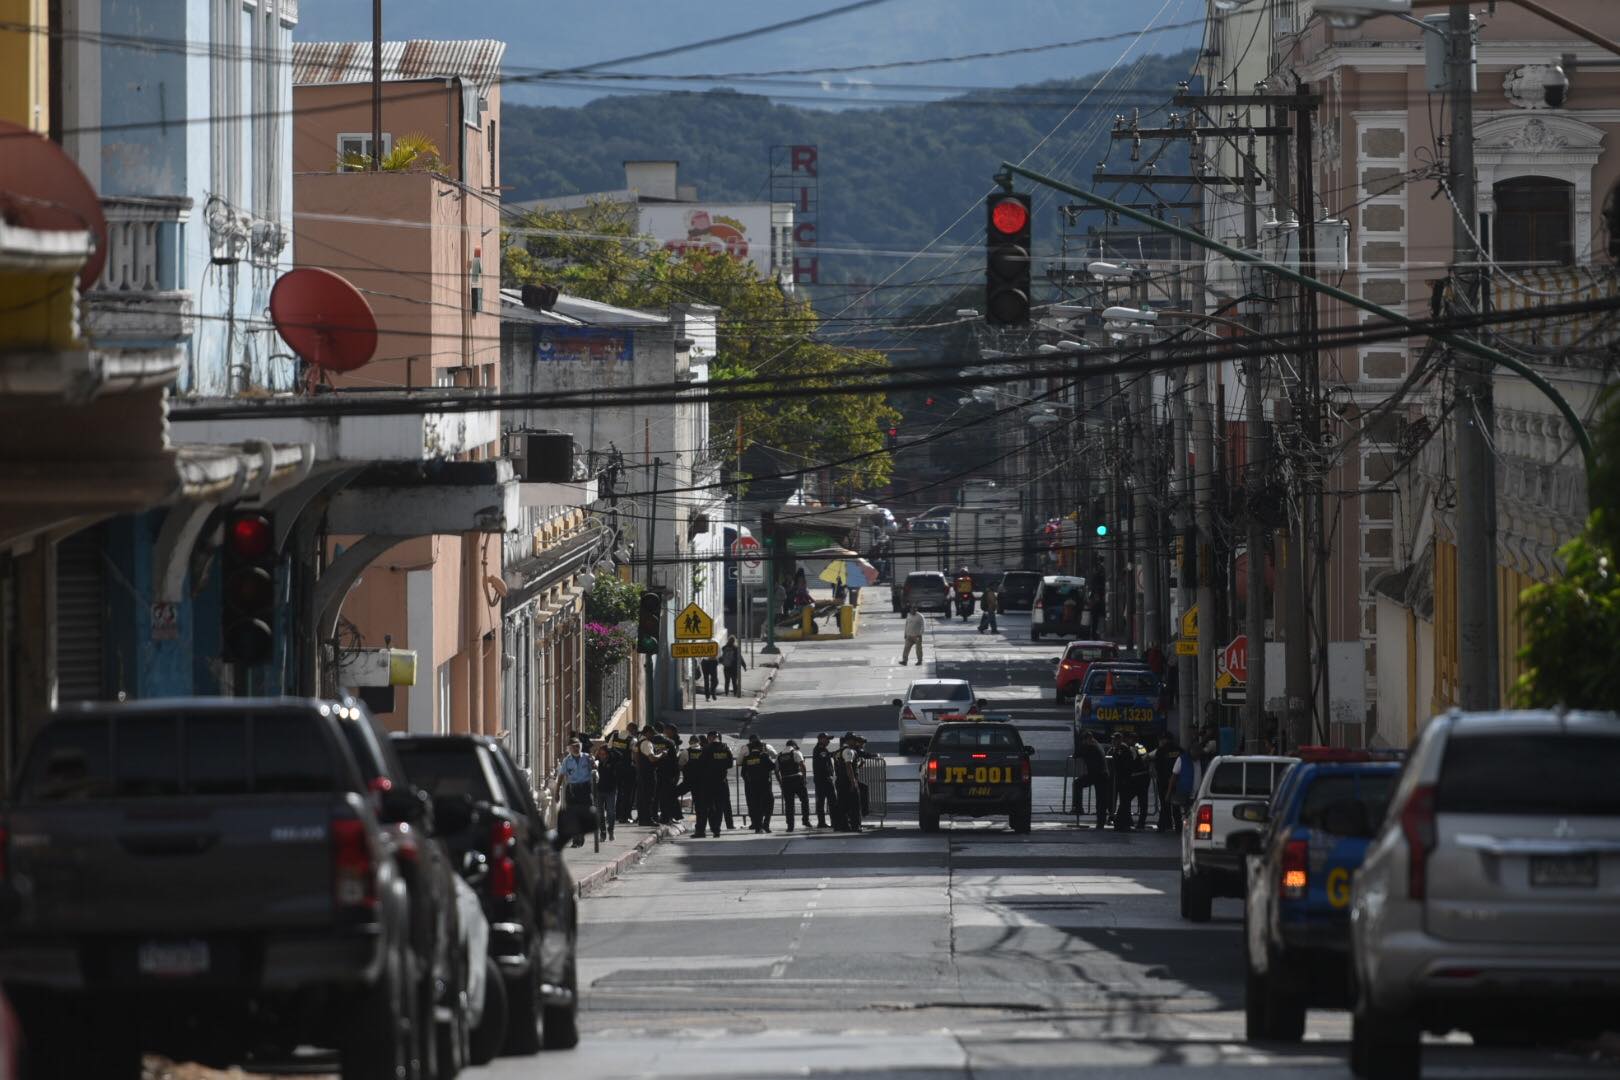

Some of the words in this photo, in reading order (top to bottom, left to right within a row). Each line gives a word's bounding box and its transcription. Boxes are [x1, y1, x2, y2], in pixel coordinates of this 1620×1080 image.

[791, 145, 817, 283] RICH
[1229, 649, 1248, 670] AL
[1096, 706, 1153, 721] GUA-13230
[944, 766, 1012, 784] JT-001
